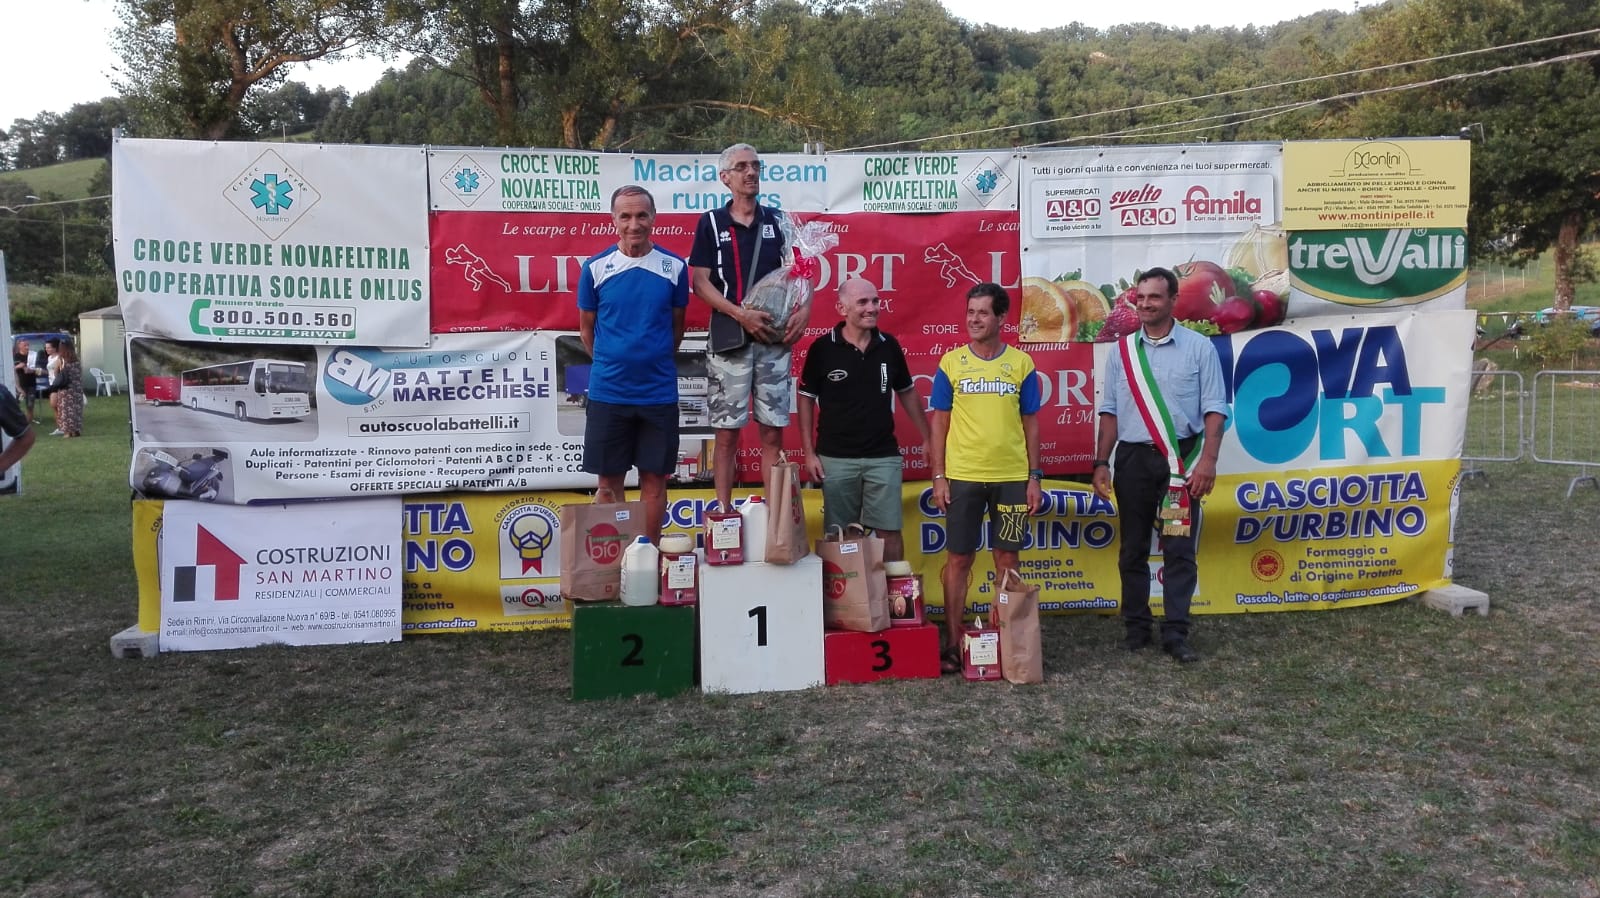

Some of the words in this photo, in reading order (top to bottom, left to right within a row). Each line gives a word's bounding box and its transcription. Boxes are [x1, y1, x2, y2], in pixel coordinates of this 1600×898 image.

[501, 154, 548, 174] CROCE
[555, 155, 600, 175] VERDE
[760, 160, 827, 182] team
[864, 158, 909, 176] CROCE
[915, 156, 958, 175] VERDE
[1032, 167, 1050, 175] Tutti
[1058, 166, 1083, 176] giorni
[1085, 164, 1114, 174] qualità
[1124, 162, 1178, 172] convenienza
[1180, 162, 1194, 170] nei
[1196, 162, 1212, 170] tuoi
[502, 179, 600, 200] NOVAFELTRIA
[863, 180, 958, 200] NOVAFELTRIA
[1045, 188, 1100, 196] SUPERMERCATI
[1110, 183, 1162, 204] svelto
[502, 201, 546, 210] COOPERATIVA
[548, 201, 574, 211] SOCIALE
[580, 202, 600, 211] ONLUS
[864, 202, 904, 211] COOPERATIVA
[937, 200, 958, 210] ONLUS
[1182, 185, 1262, 221] famila
[1318, 210, 1435, 221] www.montinipelle.it
[502, 223, 518, 235] Le
[523, 224, 566, 238] scarpe
[570, 226, 576, 234] e
[979, 220, 994, 233] Le
[134, 238, 202, 264] CROCE
[210, 242, 273, 266] VERDE
[281, 244, 410, 270] NOVAFELTRIA
[122, 270, 262, 298] COOPERATIVA
[270, 276, 352, 300] SOCIALE
[360, 278, 422, 301] ONLUS
[213, 310, 352, 327] 800.500.560
[228, 328, 286, 337] SERVIZI
[291, 329, 347, 338] PRIVATI
[922, 324, 959, 336] STORE
[392, 350, 548, 366] AUTOSCUOLE
[930, 344, 942, 356] di
[392, 366, 549, 386] BATTELLI
[392, 384, 550, 402] MARECCHIESE
[359, 416, 520, 434] autoscuolabattelli.it
[250, 448, 278, 458] Aule
[279, 447, 357, 458] informatizzate
[368, 446, 410, 457] Rinnovo
[414, 446, 451, 457] patenti
[454, 446, 472, 454] con
[475, 444, 512, 454] medico
[515, 443, 526, 452] in
[528, 443, 552, 452] sede
[246, 458, 293, 470] Duplicati
[304, 458, 352, 469] Patentini
[355, 460, 374, 469] per
[376, 456, 435, 468] Ciclomotori
[446, 454, 482, 465] Patenti
[485, 454, 493, 464] A
[496, 454, 503, 463] B
[506, 454, 515, 463] C
[516, 454, 524, 463] D
[527, 454, 533, 462] E
[546, 453, 553, 462] K
[275, 470, 319, 480] Persone
[330, 470, 365, 480] Esami
[368, 470, 376, 478] di
[378, 468, 426, 478] revisione
[437, 466, 486, 478] Recupero
[489, 464, 515, 476] punti
[518, 464, 554, 476] patenti
[556, 466, 563, 474] e
[350, 482, 395, 492] OFFERTE
[397, 480, 442, 490] SPECIALI
[445, 479, 459, 489] SU
[462, 478, 504, 488] PATENTI
[506, 478, 528, 488] A/B
[1235, 472, 1428, 512] CASCIOTTA
[1234, 505, 1428, 544] D'URBINO
[256, 545, 390, 566] COSTRUZIONI
[1306, 547, 1376, 559] Formaggio
[1380, 547, 1388, 555] a
[1298, 557, 1397, 570] Denominazione
[256, 570, 293, 585] SAN
[302, 566, 393, 583] MARTINO
[1290, 572, 1302, 582] di
[1305, 570, 1354, 583] Origine
[1358, 568, 1403, 579] Protetta
[255, 590, 316, 600] RESIDENZIALI
[325, 587, 391, 598] COMMERCIALI
[979, 582, 991, 593] di
[1045, 580, 1095, 592] Protetta
[1236, 592, 1282, 605] Pascolo,
[1284, 590, 1310, 603] latte
[1312, 592, 1319, 601] e
[1322, 588, 1367, 602] sapienza
[1369, 582, 1419, 597] contadina
[1062, 598, 1117, 610] contadina
[167, 618, 184, 627] Sede
[185, 618, 192, 626] in
[217, 616, 229, 625] Via
[230, 613, 285, 624] Circonvallazione
[286, 612, 308, 621] Nuova
[417, 617, 477, 629] contadina
[747, 605, 768, 646] 1
[620, 634, 645, 667] 2
[870, 640, 892, 672] 3
